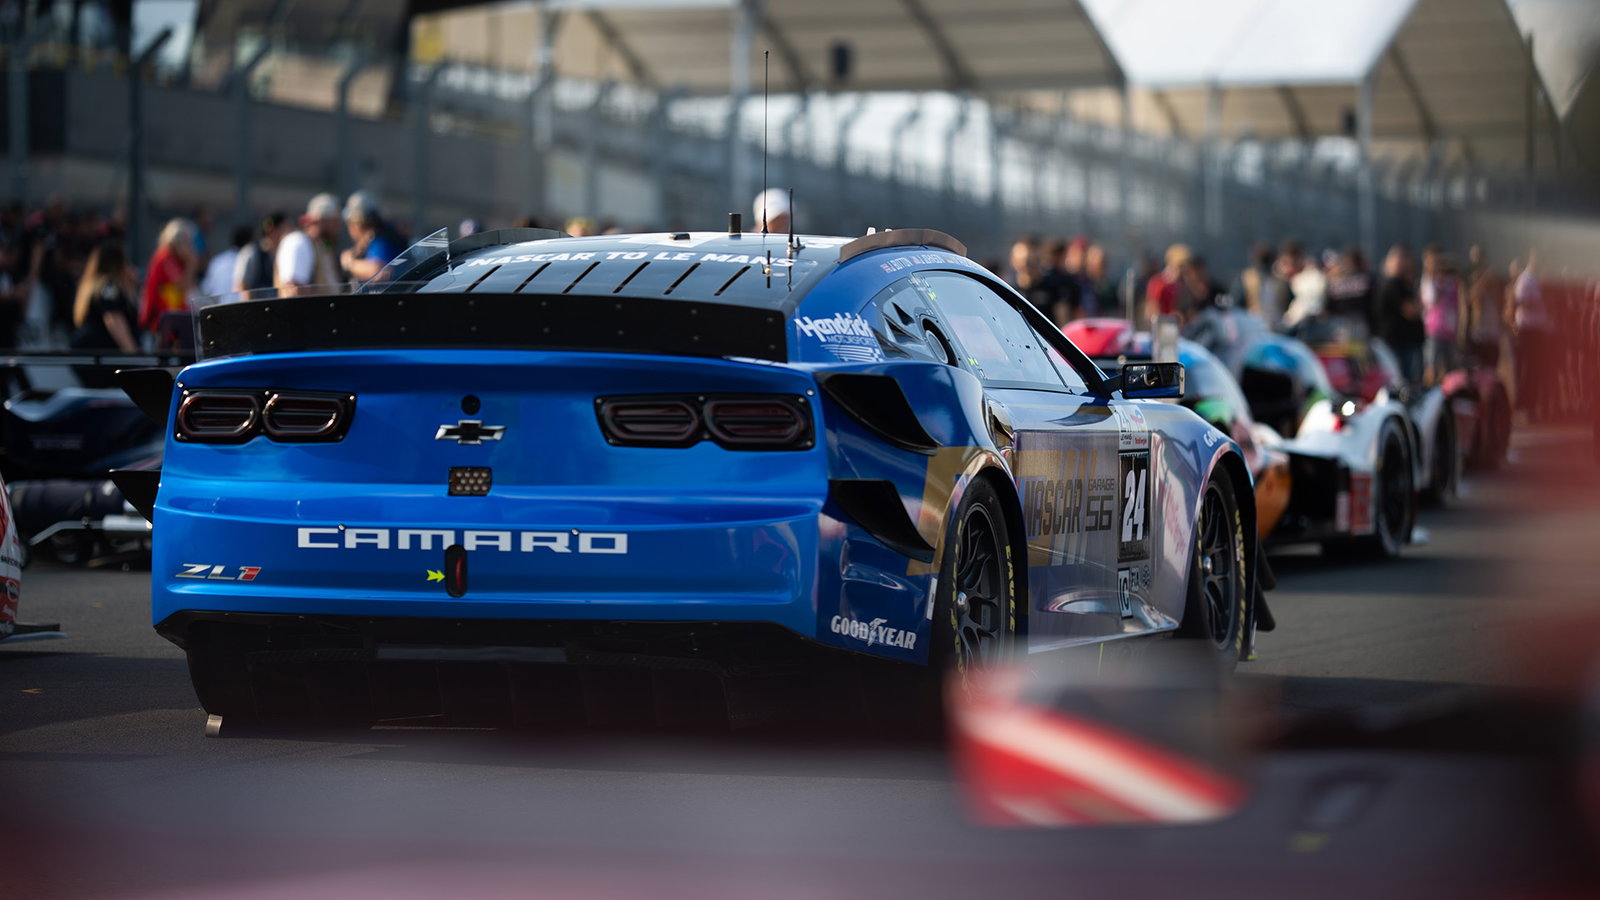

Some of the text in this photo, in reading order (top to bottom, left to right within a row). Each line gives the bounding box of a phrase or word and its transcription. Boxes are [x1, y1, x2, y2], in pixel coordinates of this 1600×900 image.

[468, 251, 798, 267] NASCAR TO LE MANS
[793, 312, 874, 342] Hendrick
[1088, 478, 1115, 491] GARAGE
[1024, 479, 1083, 537] NASCAR
[1085, 495, 1114, 532] 56
[1121, 468, 1147, 543] 24
[297, 527, 628, 554] CAMARO
[175, 563, 262, 581] ZL1
[830, 615, 917, 650] GOODYEAR
